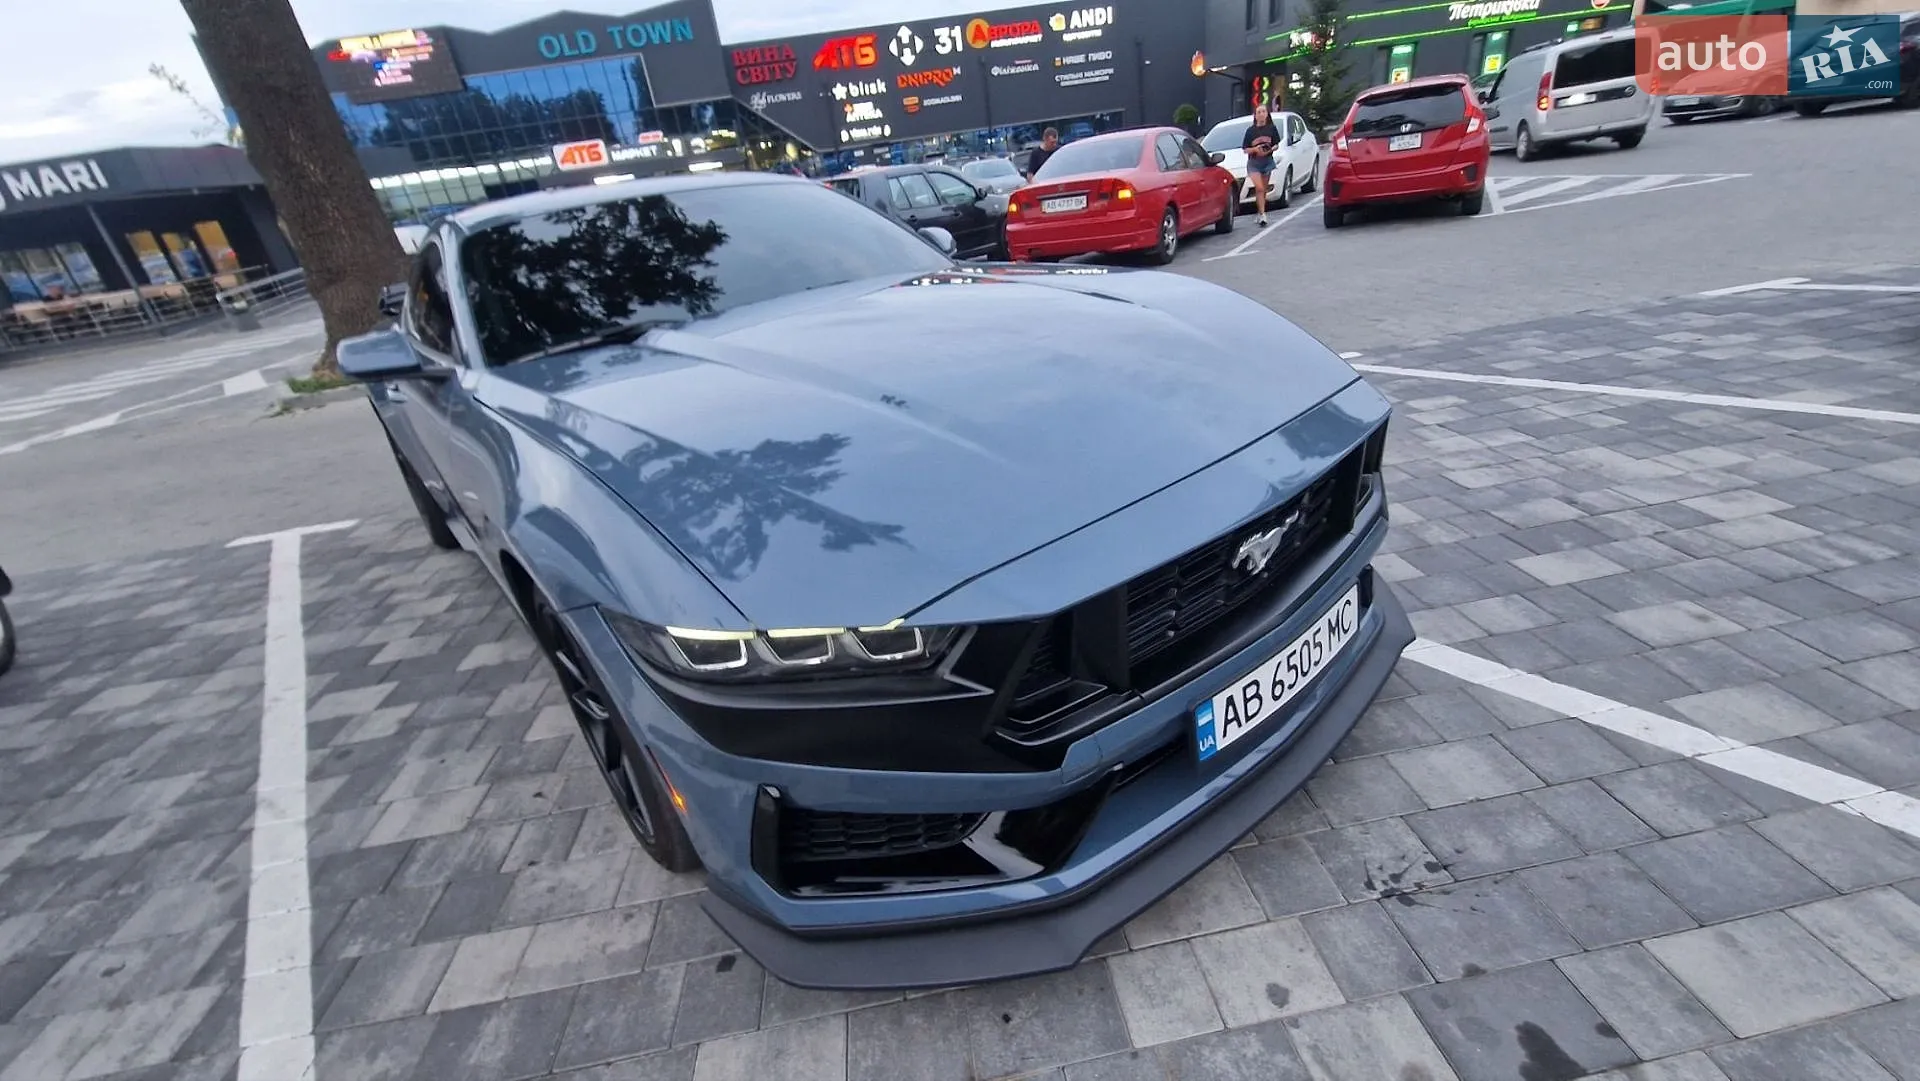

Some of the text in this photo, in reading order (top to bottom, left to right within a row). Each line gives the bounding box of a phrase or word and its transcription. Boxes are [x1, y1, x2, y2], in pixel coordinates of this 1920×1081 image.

[1070, 6, 1113, 29] ANDI
[538, 17, 694, 59] OLD TOWN
[933, 25, 963, 55] 31
[732, 44, 796, 66] ВИНА
[736, 61, 797, 85] СВІТУ
[2, 159, 109, 201] MARI
[1222, 599, 1352, 739] AB 6505 MC
[1200, 735, 1215, 752] UA
